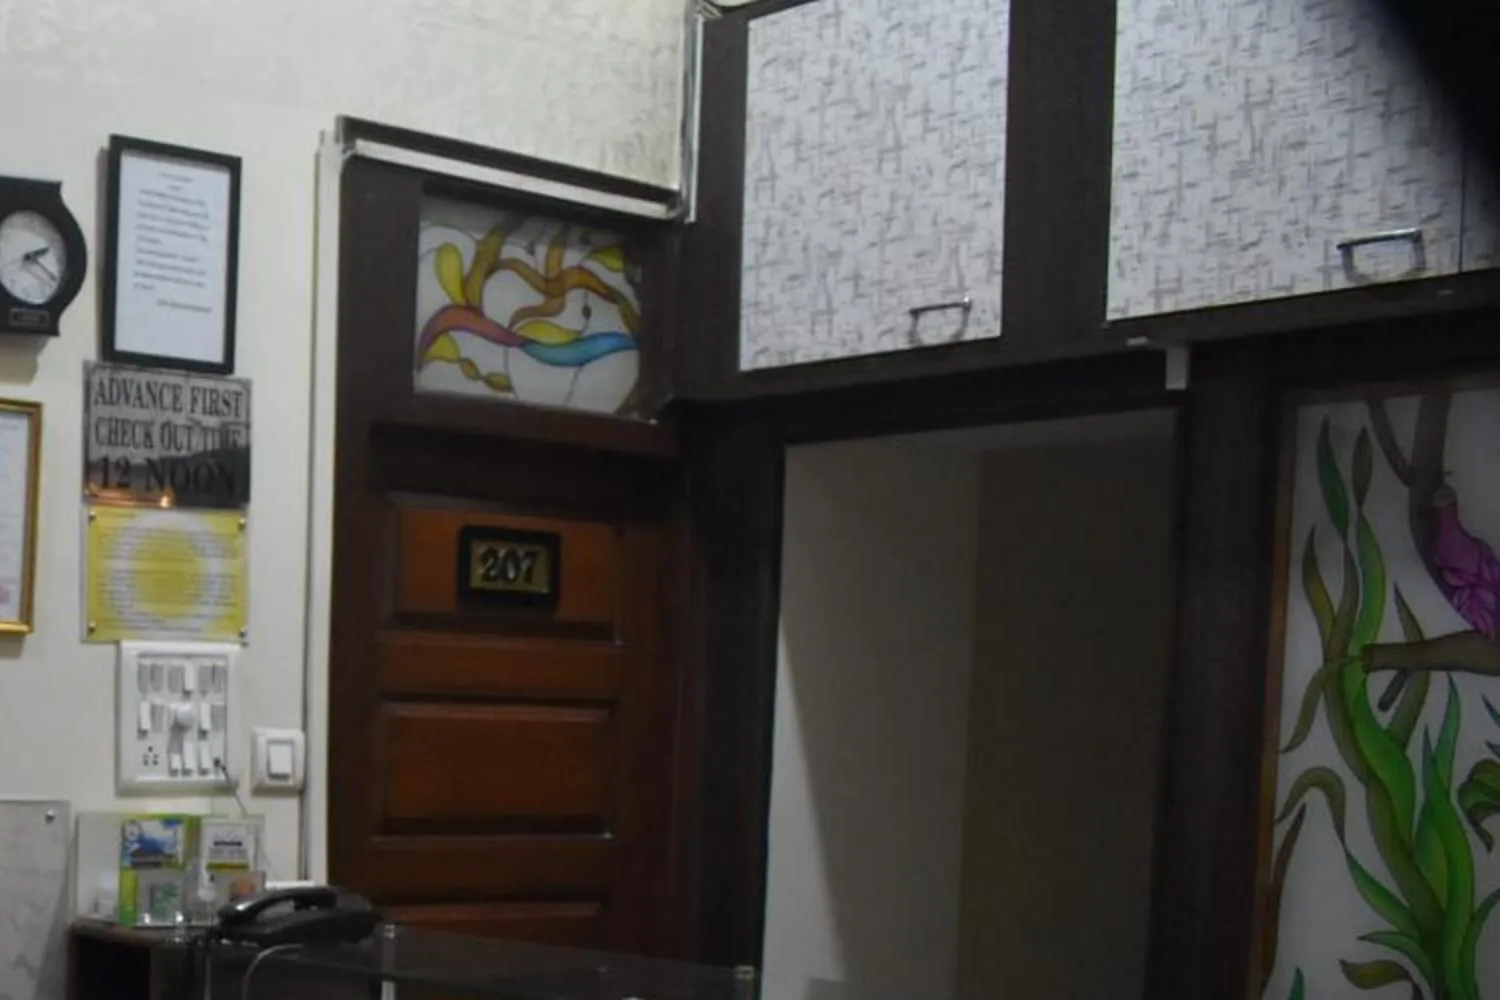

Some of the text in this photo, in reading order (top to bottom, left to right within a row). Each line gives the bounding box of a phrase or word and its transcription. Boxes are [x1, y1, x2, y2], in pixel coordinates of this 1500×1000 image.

[94, 376, 244, 418] ADVANCE FIRST
[94, 415, 154, 450] CHECK
[160, 420, 192, 452] OUT
[101, 455, 236, 496] 12 NOON
[480, 547, 538, 584] 207
